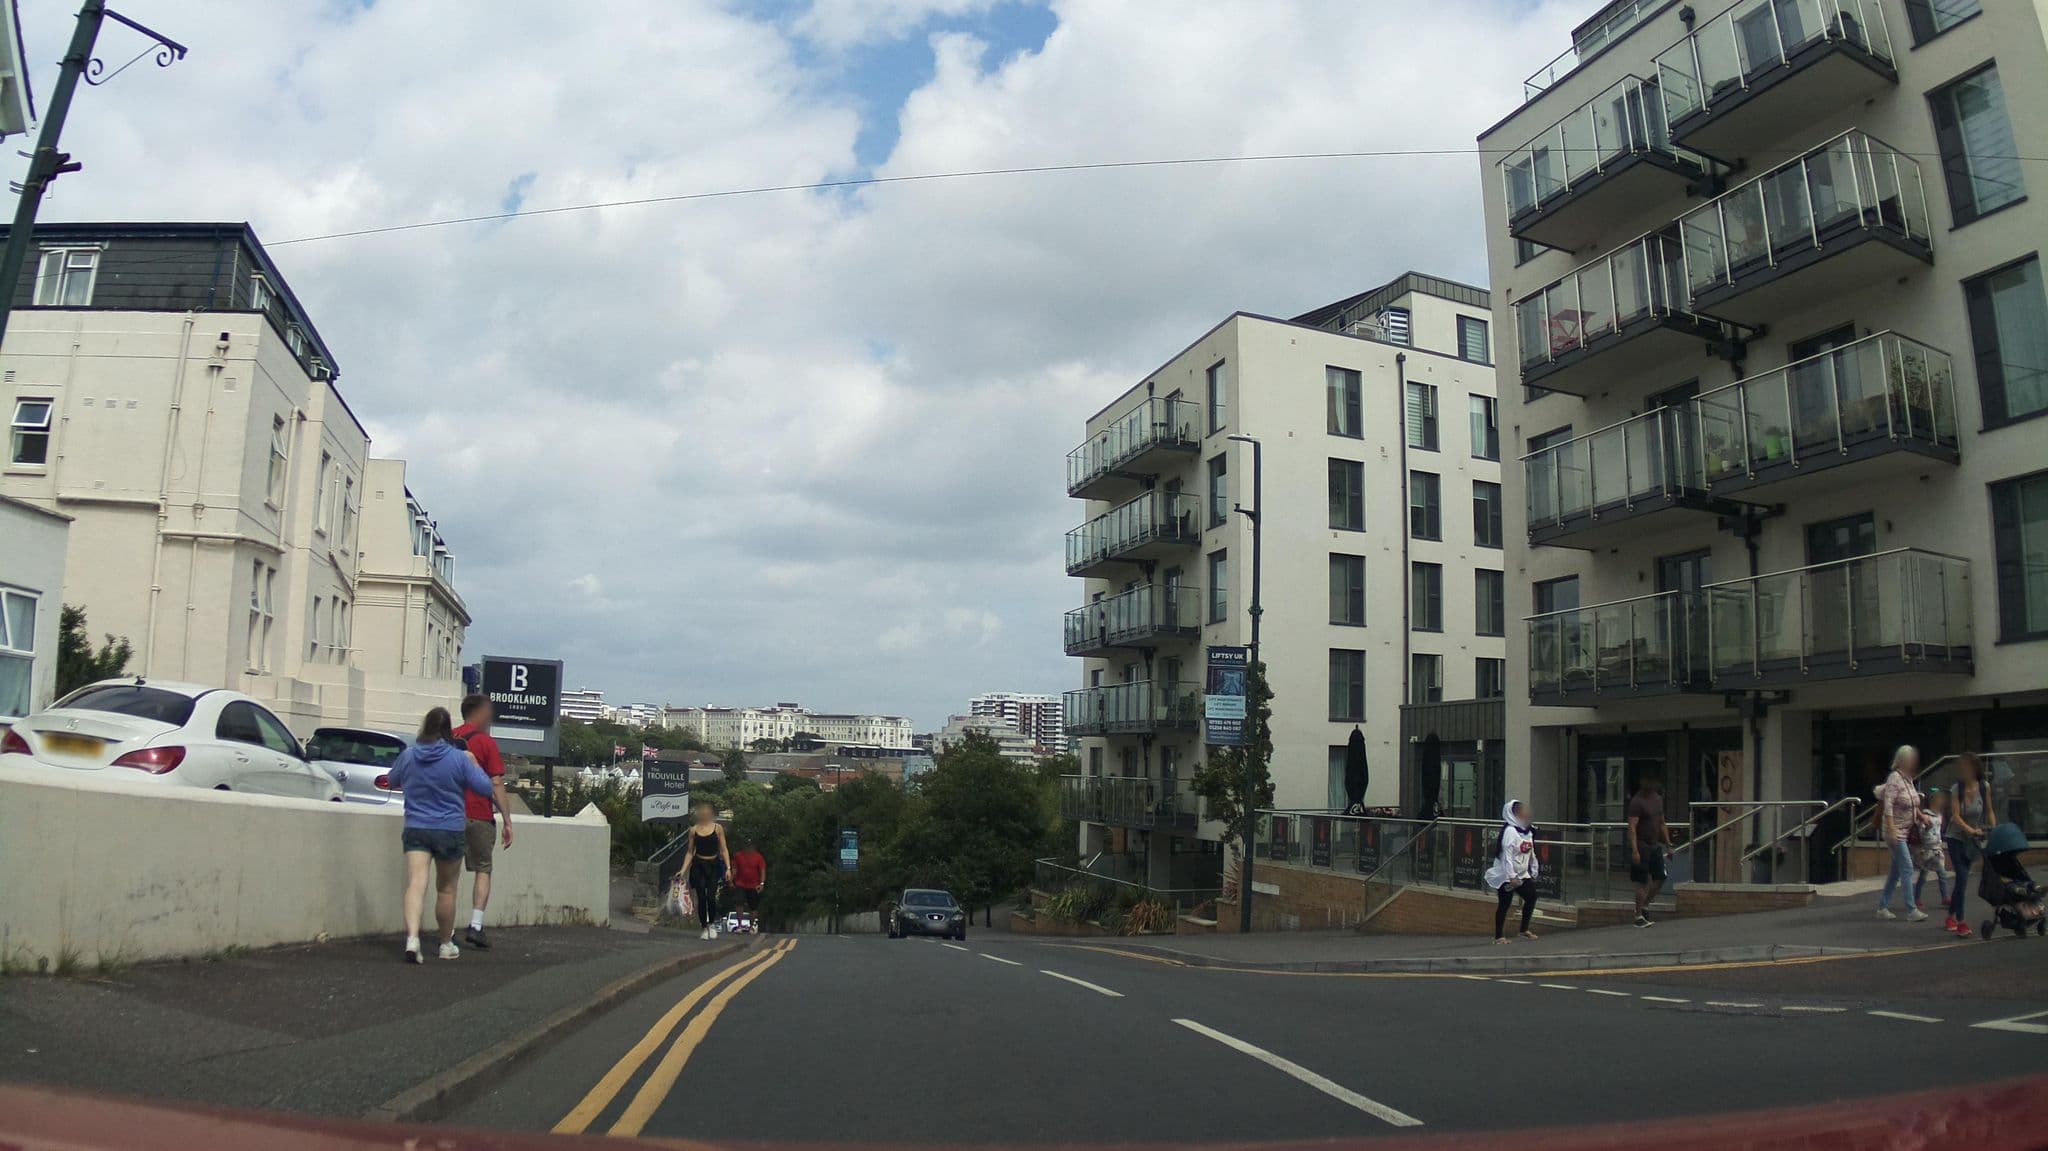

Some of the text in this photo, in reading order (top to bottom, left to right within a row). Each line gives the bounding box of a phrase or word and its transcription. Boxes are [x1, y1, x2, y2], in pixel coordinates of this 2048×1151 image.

[511, 664, 528, 692] B
[490, 692, 547, 706] BROOKLANDS
[647, 772, 685, 781] TROUVILLE
[664, 781, 685, 789] Hotel
